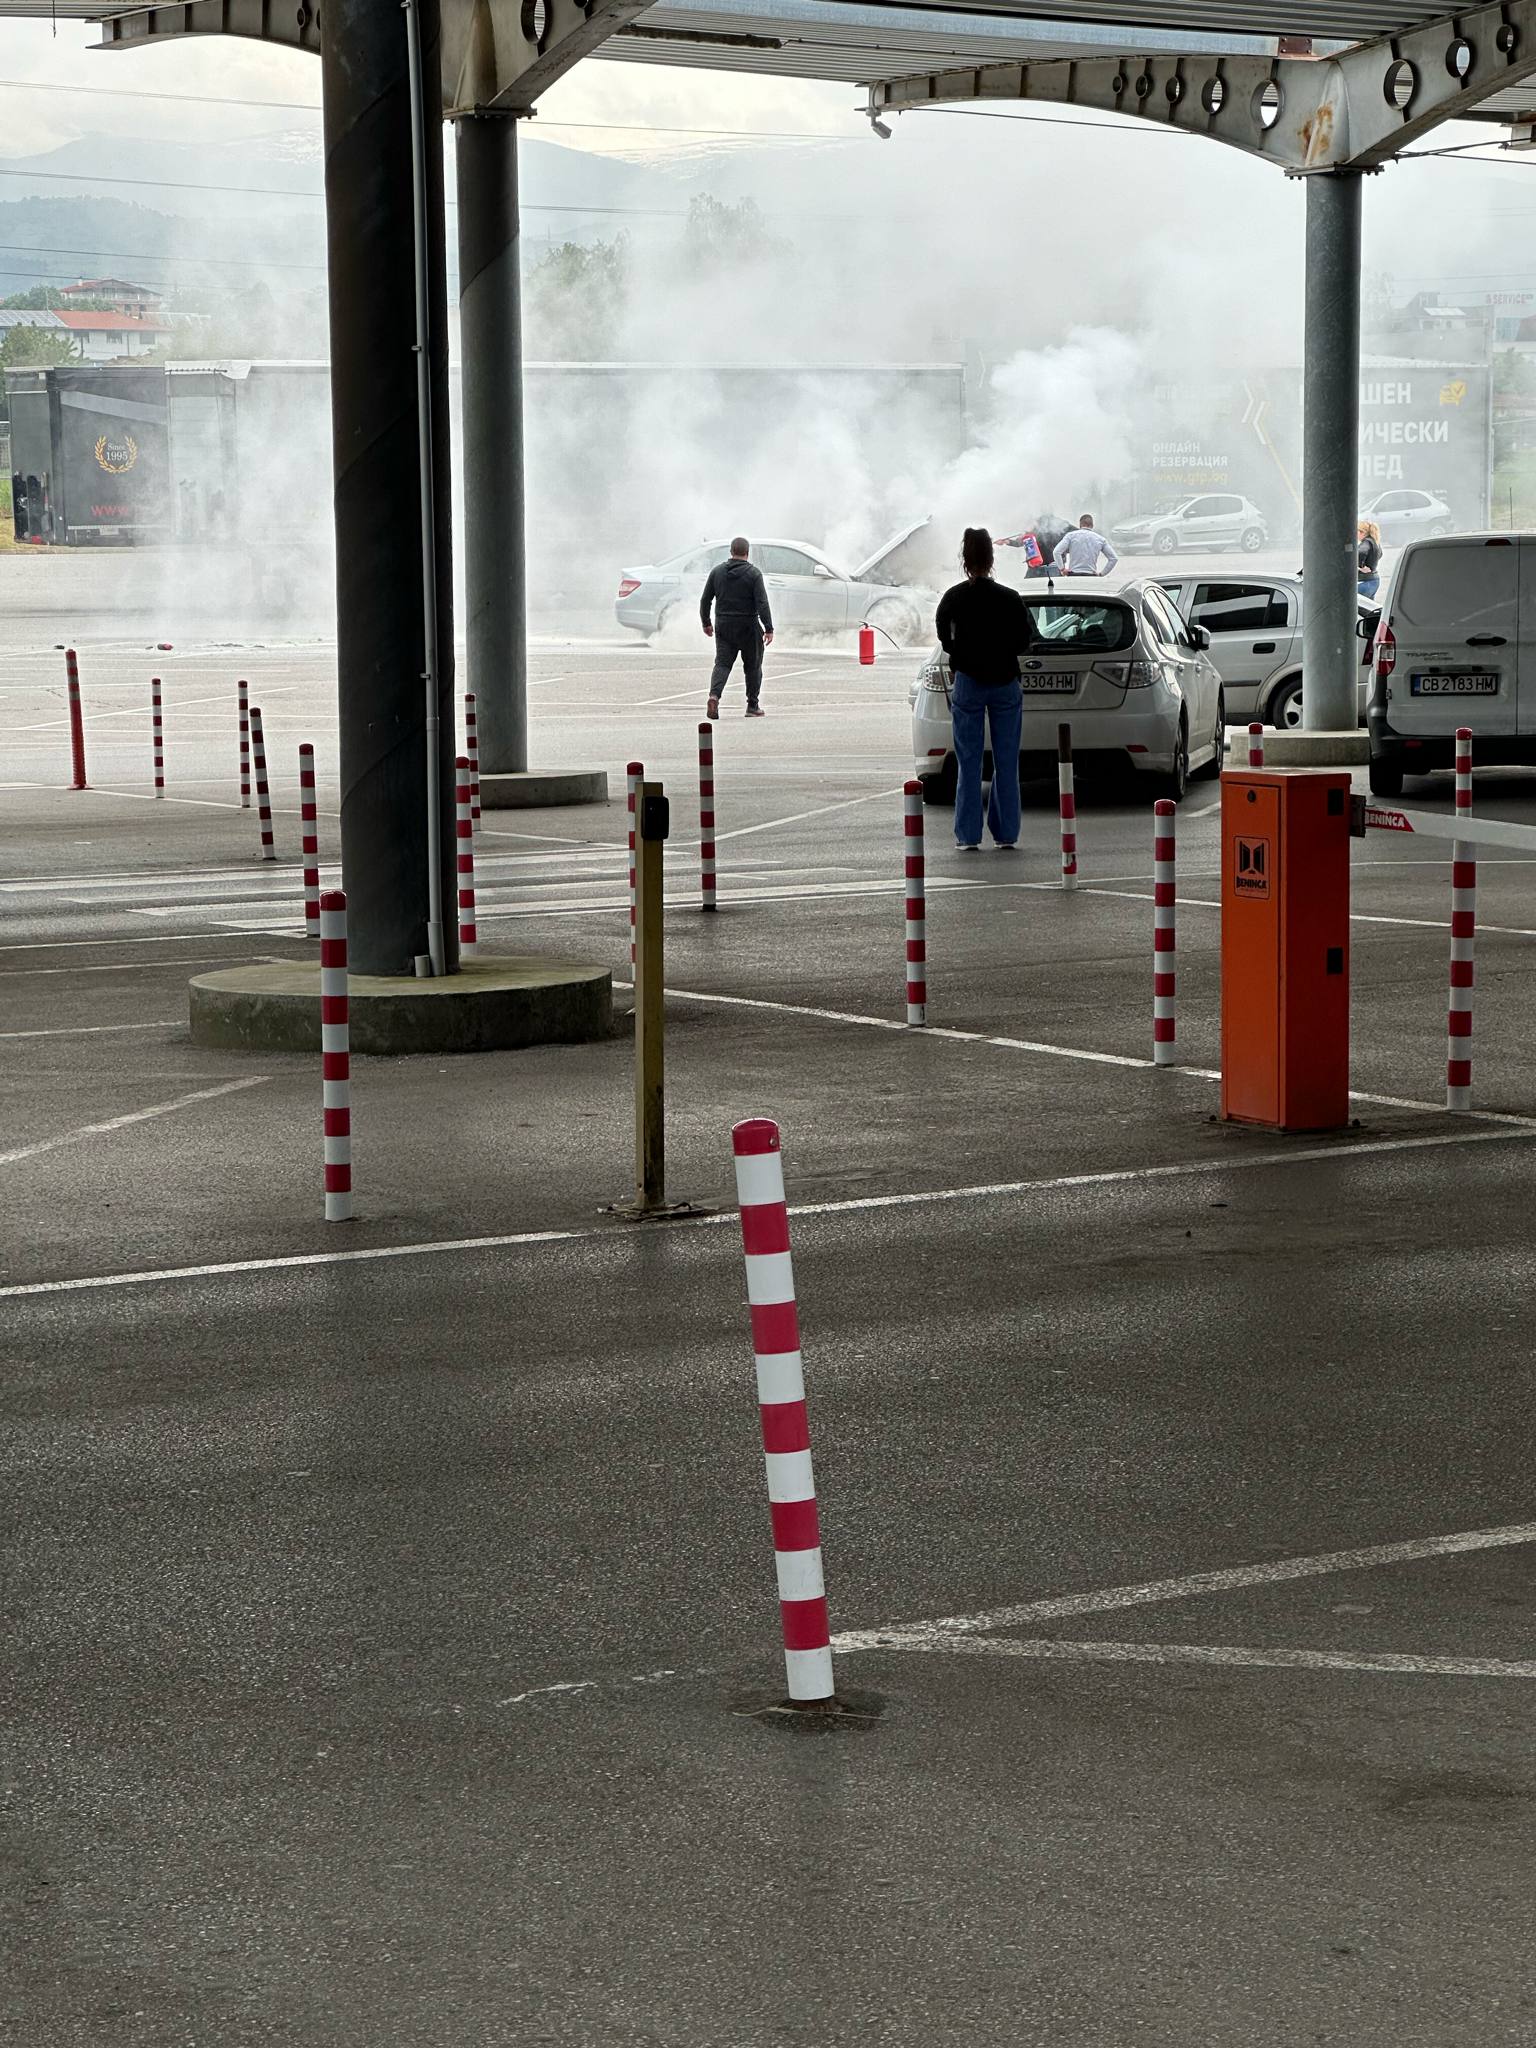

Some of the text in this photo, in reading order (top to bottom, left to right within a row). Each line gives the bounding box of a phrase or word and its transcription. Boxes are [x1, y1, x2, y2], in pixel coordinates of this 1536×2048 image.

[1360, 382, 1411, 405] ШЕН
[106, 451, 128, 461] 1995
[1152, 455, 1229, 469] РЕЗЕРВАЦИЯ
[1022, 675, 1073, 689] 3304 HM
